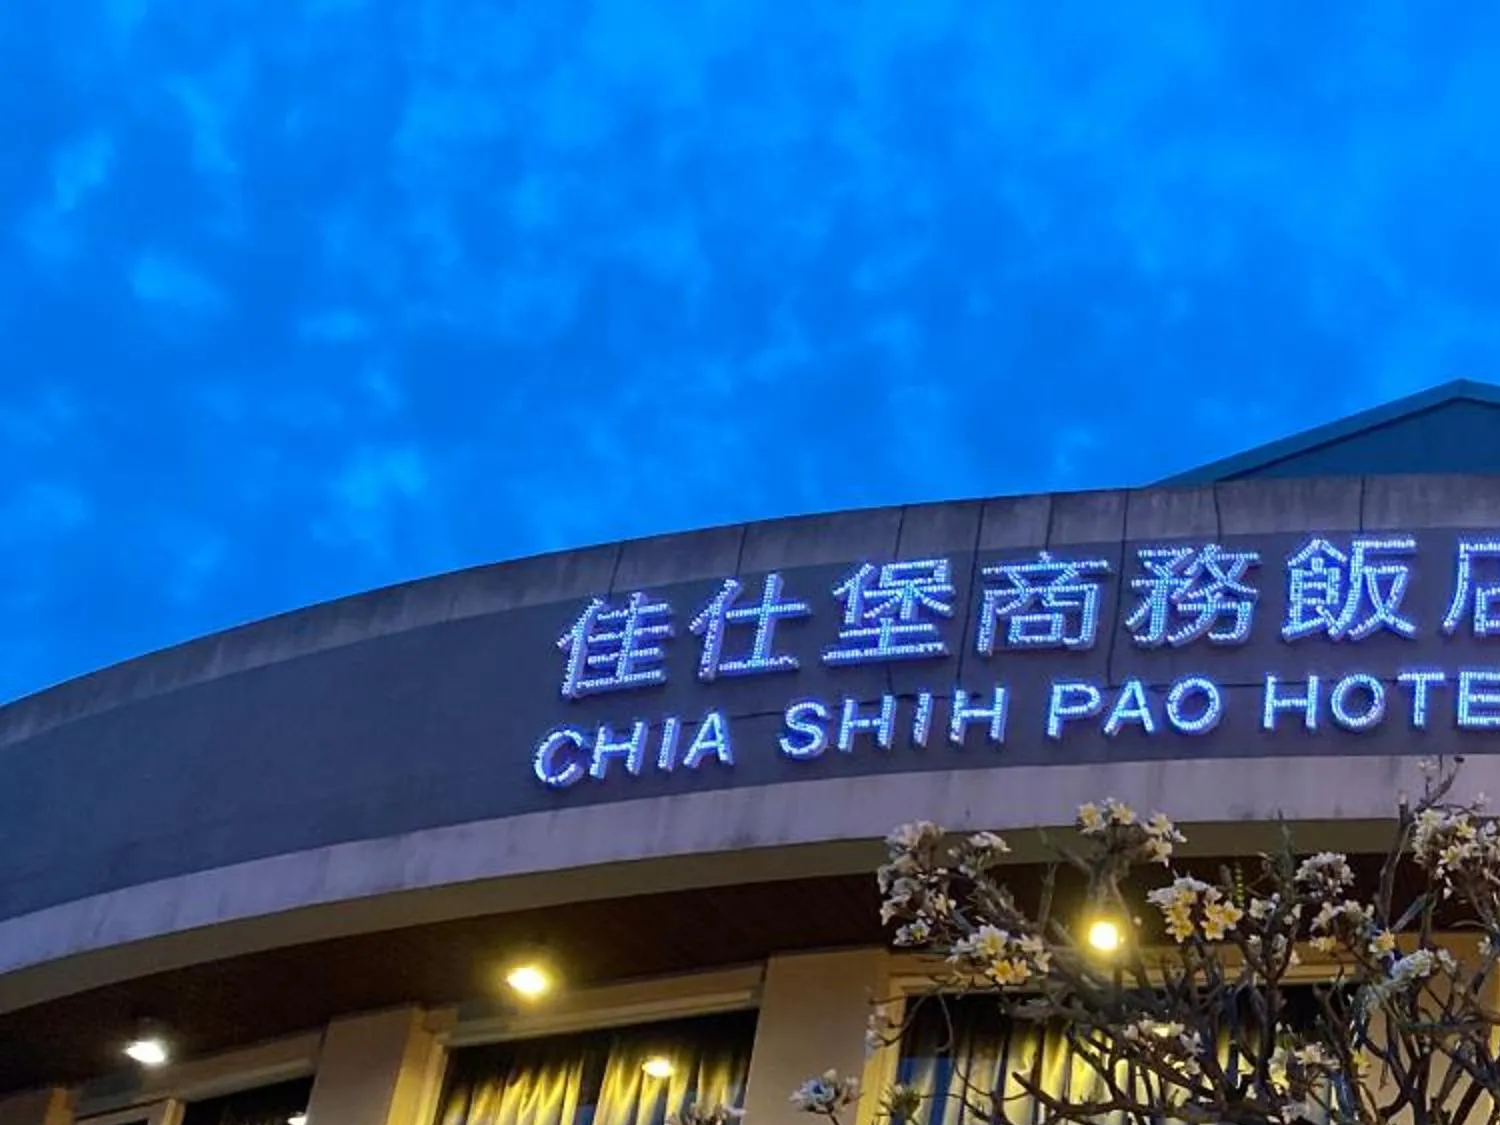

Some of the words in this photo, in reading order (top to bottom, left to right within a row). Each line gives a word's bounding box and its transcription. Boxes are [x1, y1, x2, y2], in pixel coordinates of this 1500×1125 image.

[533, 708, 735, 788] CHIA
[778, 686, 1009, 760] SHIH
[1046, 675, 1223, 740] PAO
